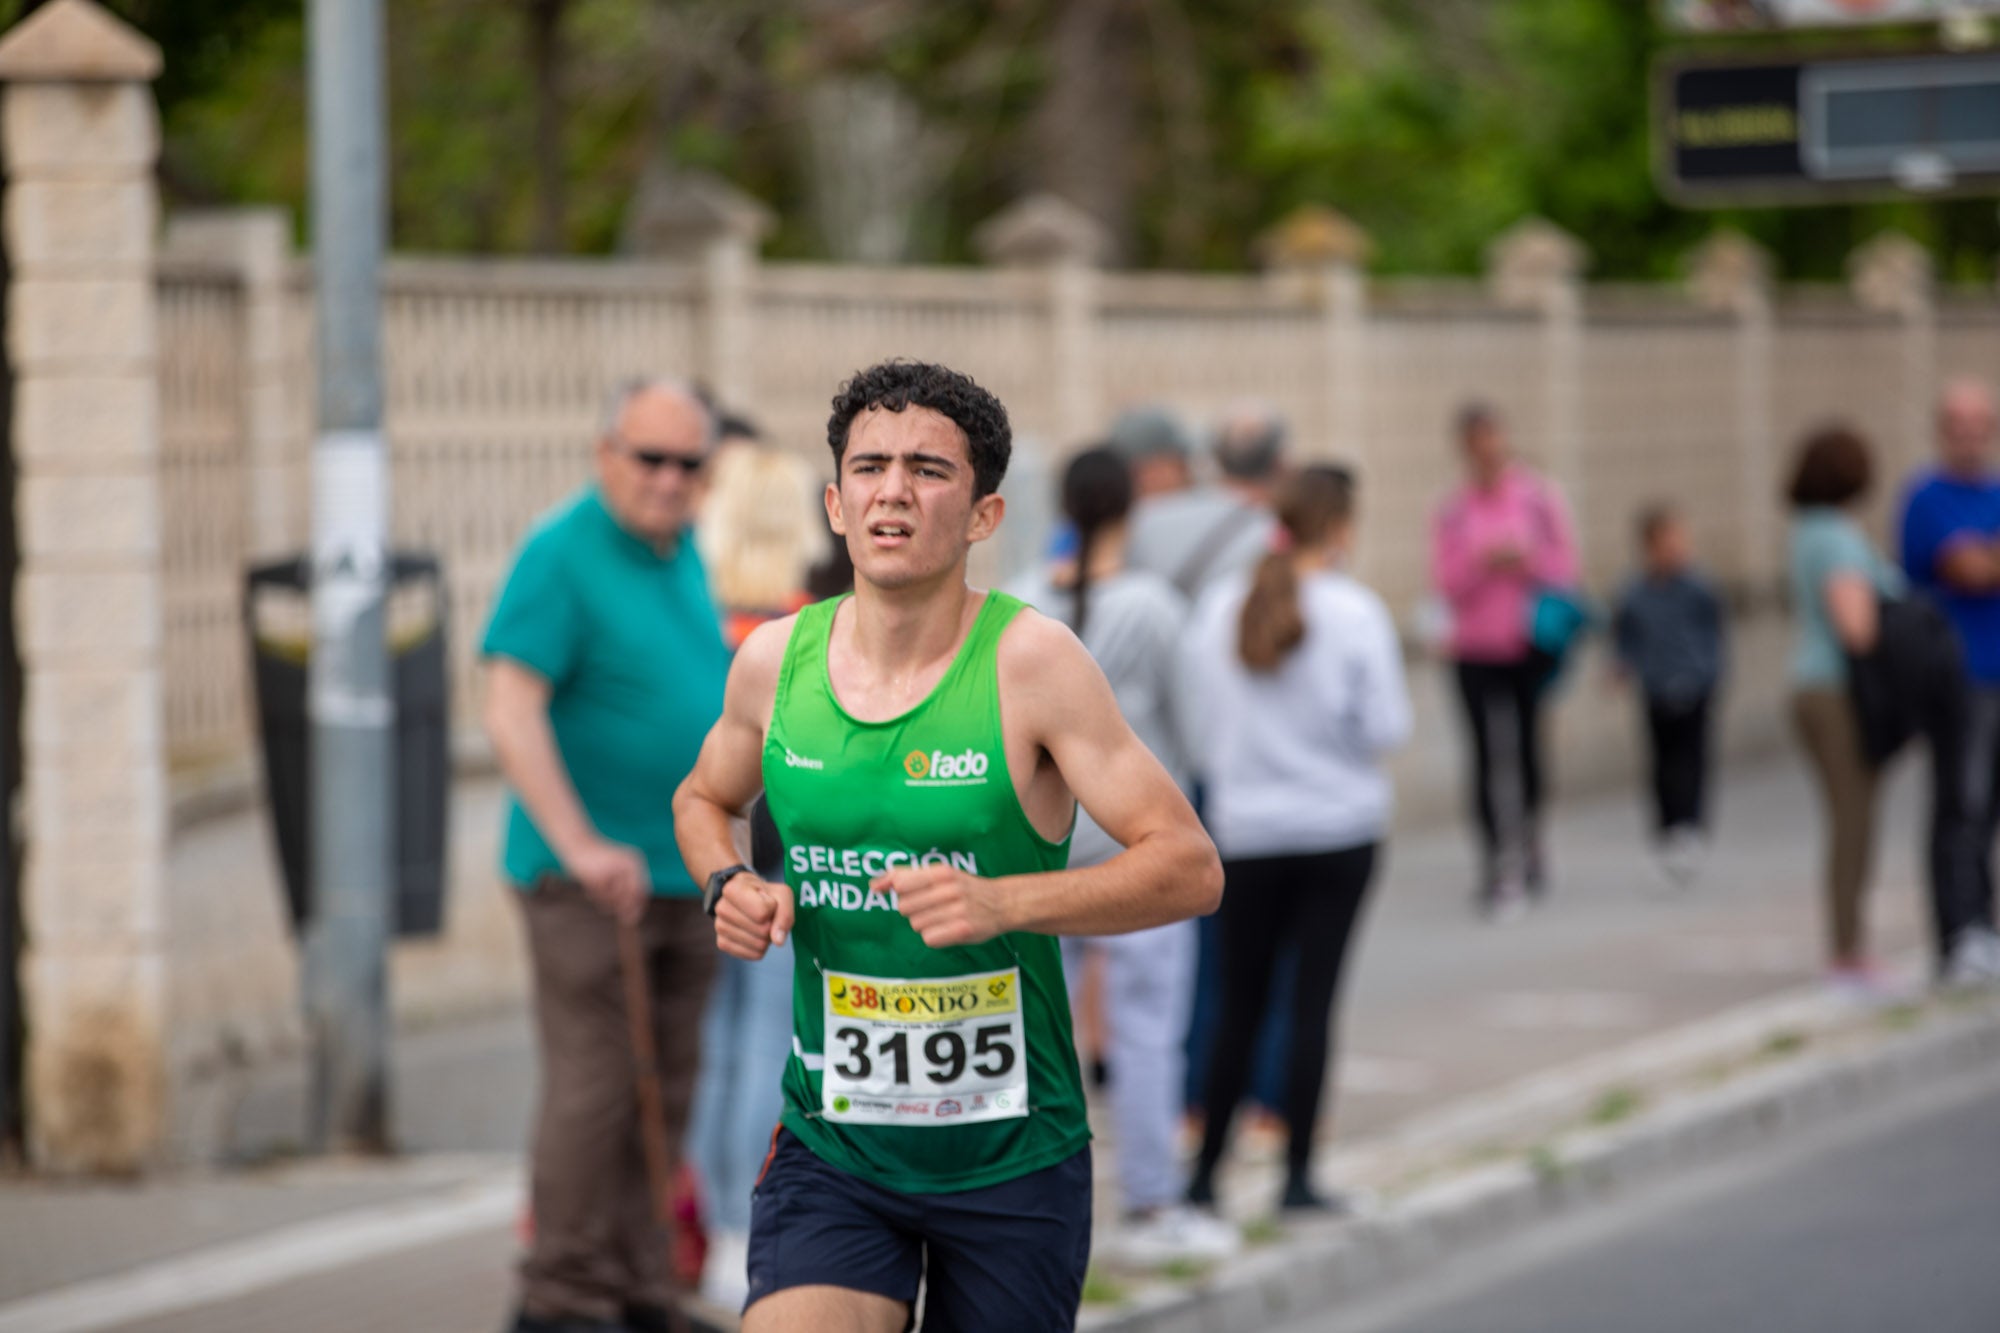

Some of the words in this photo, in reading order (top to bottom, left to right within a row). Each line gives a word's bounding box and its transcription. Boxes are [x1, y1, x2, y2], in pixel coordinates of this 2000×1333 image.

[930, 748, 989, 778] fado
[850, 985, 878, 1009] 38
[882, 985, 917, 996] GRAN
[919, 984, 969, 996] PREMIO
[879, 993, 979, 1014] FONDO
[834, 1024, 1015, 1085] 3195
